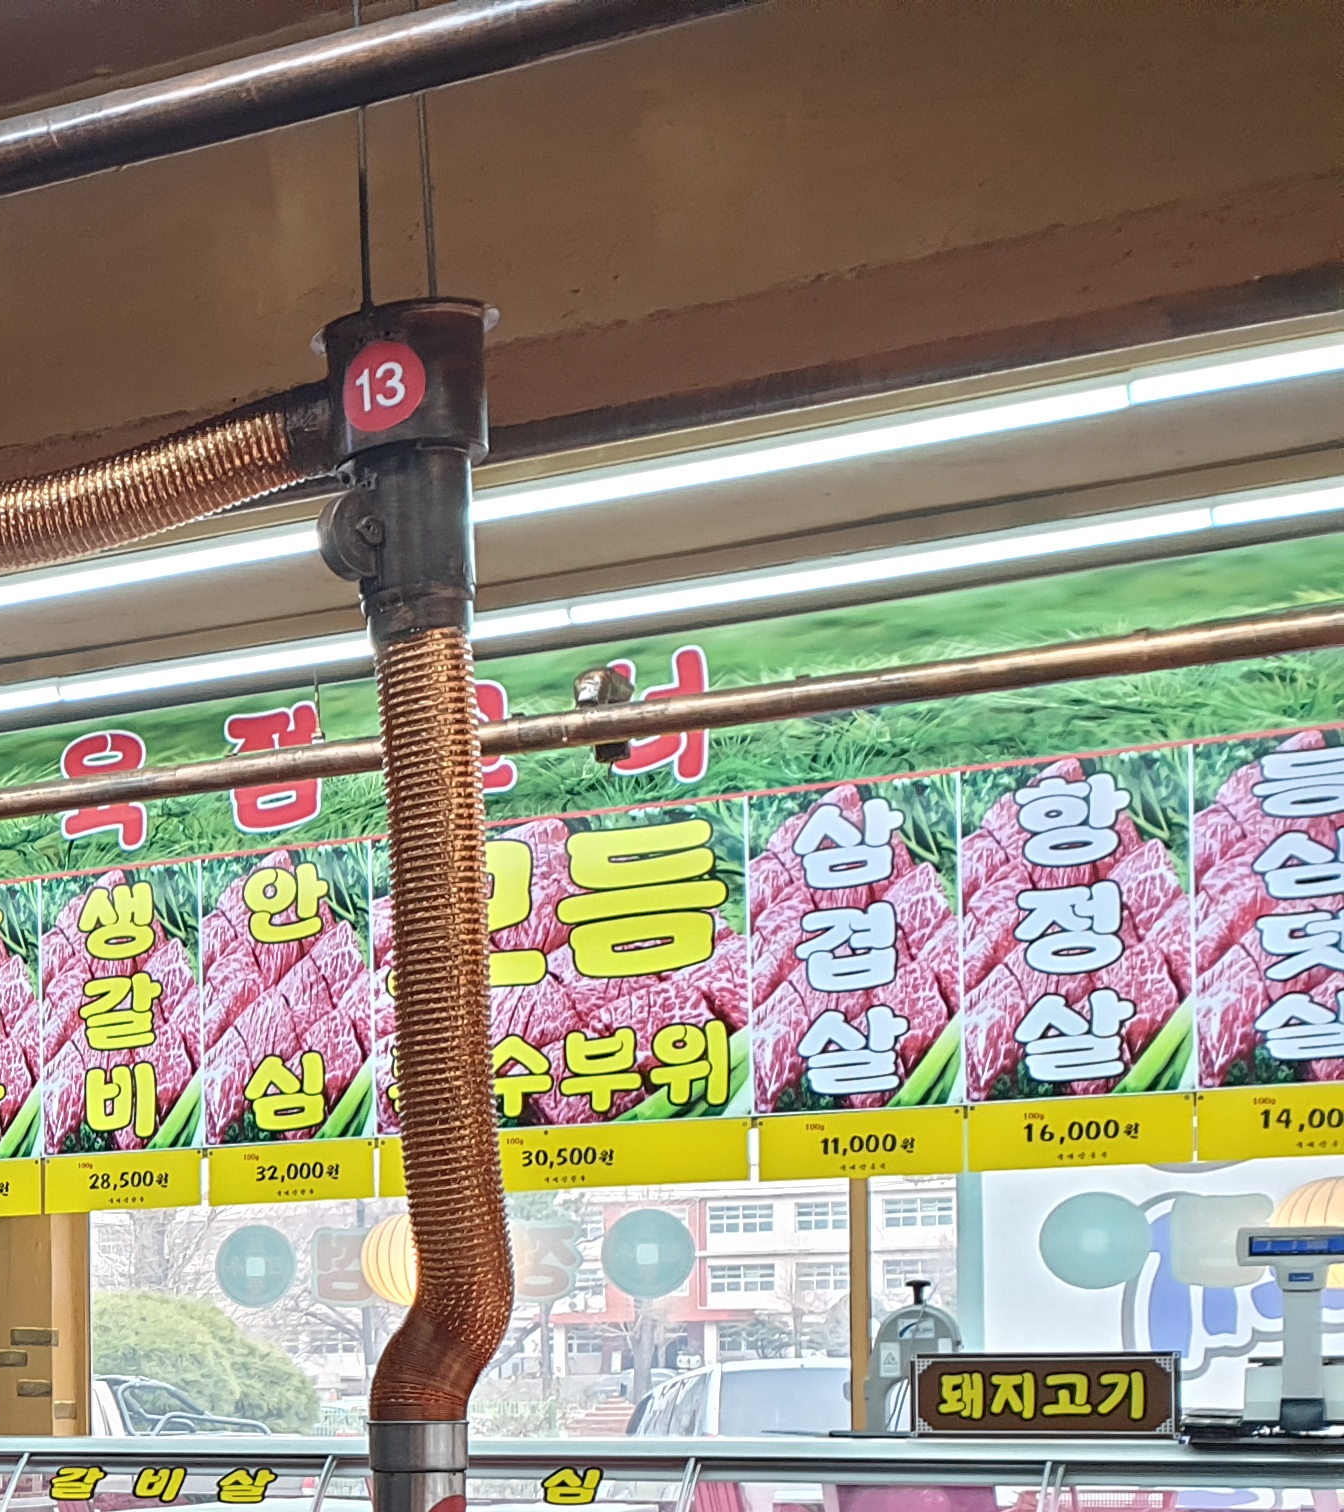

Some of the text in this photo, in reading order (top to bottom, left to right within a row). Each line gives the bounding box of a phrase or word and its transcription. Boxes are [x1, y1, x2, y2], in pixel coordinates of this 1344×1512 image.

[355, 361, 406, 412] 13
[792, 797, 909, 1095] 삼겹살
[1014, 774, 1136, 1082] 항정살
[78, 878, 164, 1141] 생갈비
[242, 862, 331, 1132] 안심
[493, 1018, 734, 1117] 수부위
[820, 1133, 915, 1156] 11,000원
[1023, 1119, 1140, 1145] 16,000원
[88, 1170, 169, 1191] 28,500원
[255, 1161, 340, 1182] 32,000원
[521, 1147, 615, 1169] 30,500원
[937, 1370, 1145, 1420] 돼지고기
[48, 1465, 278, 1504] 갈비살
